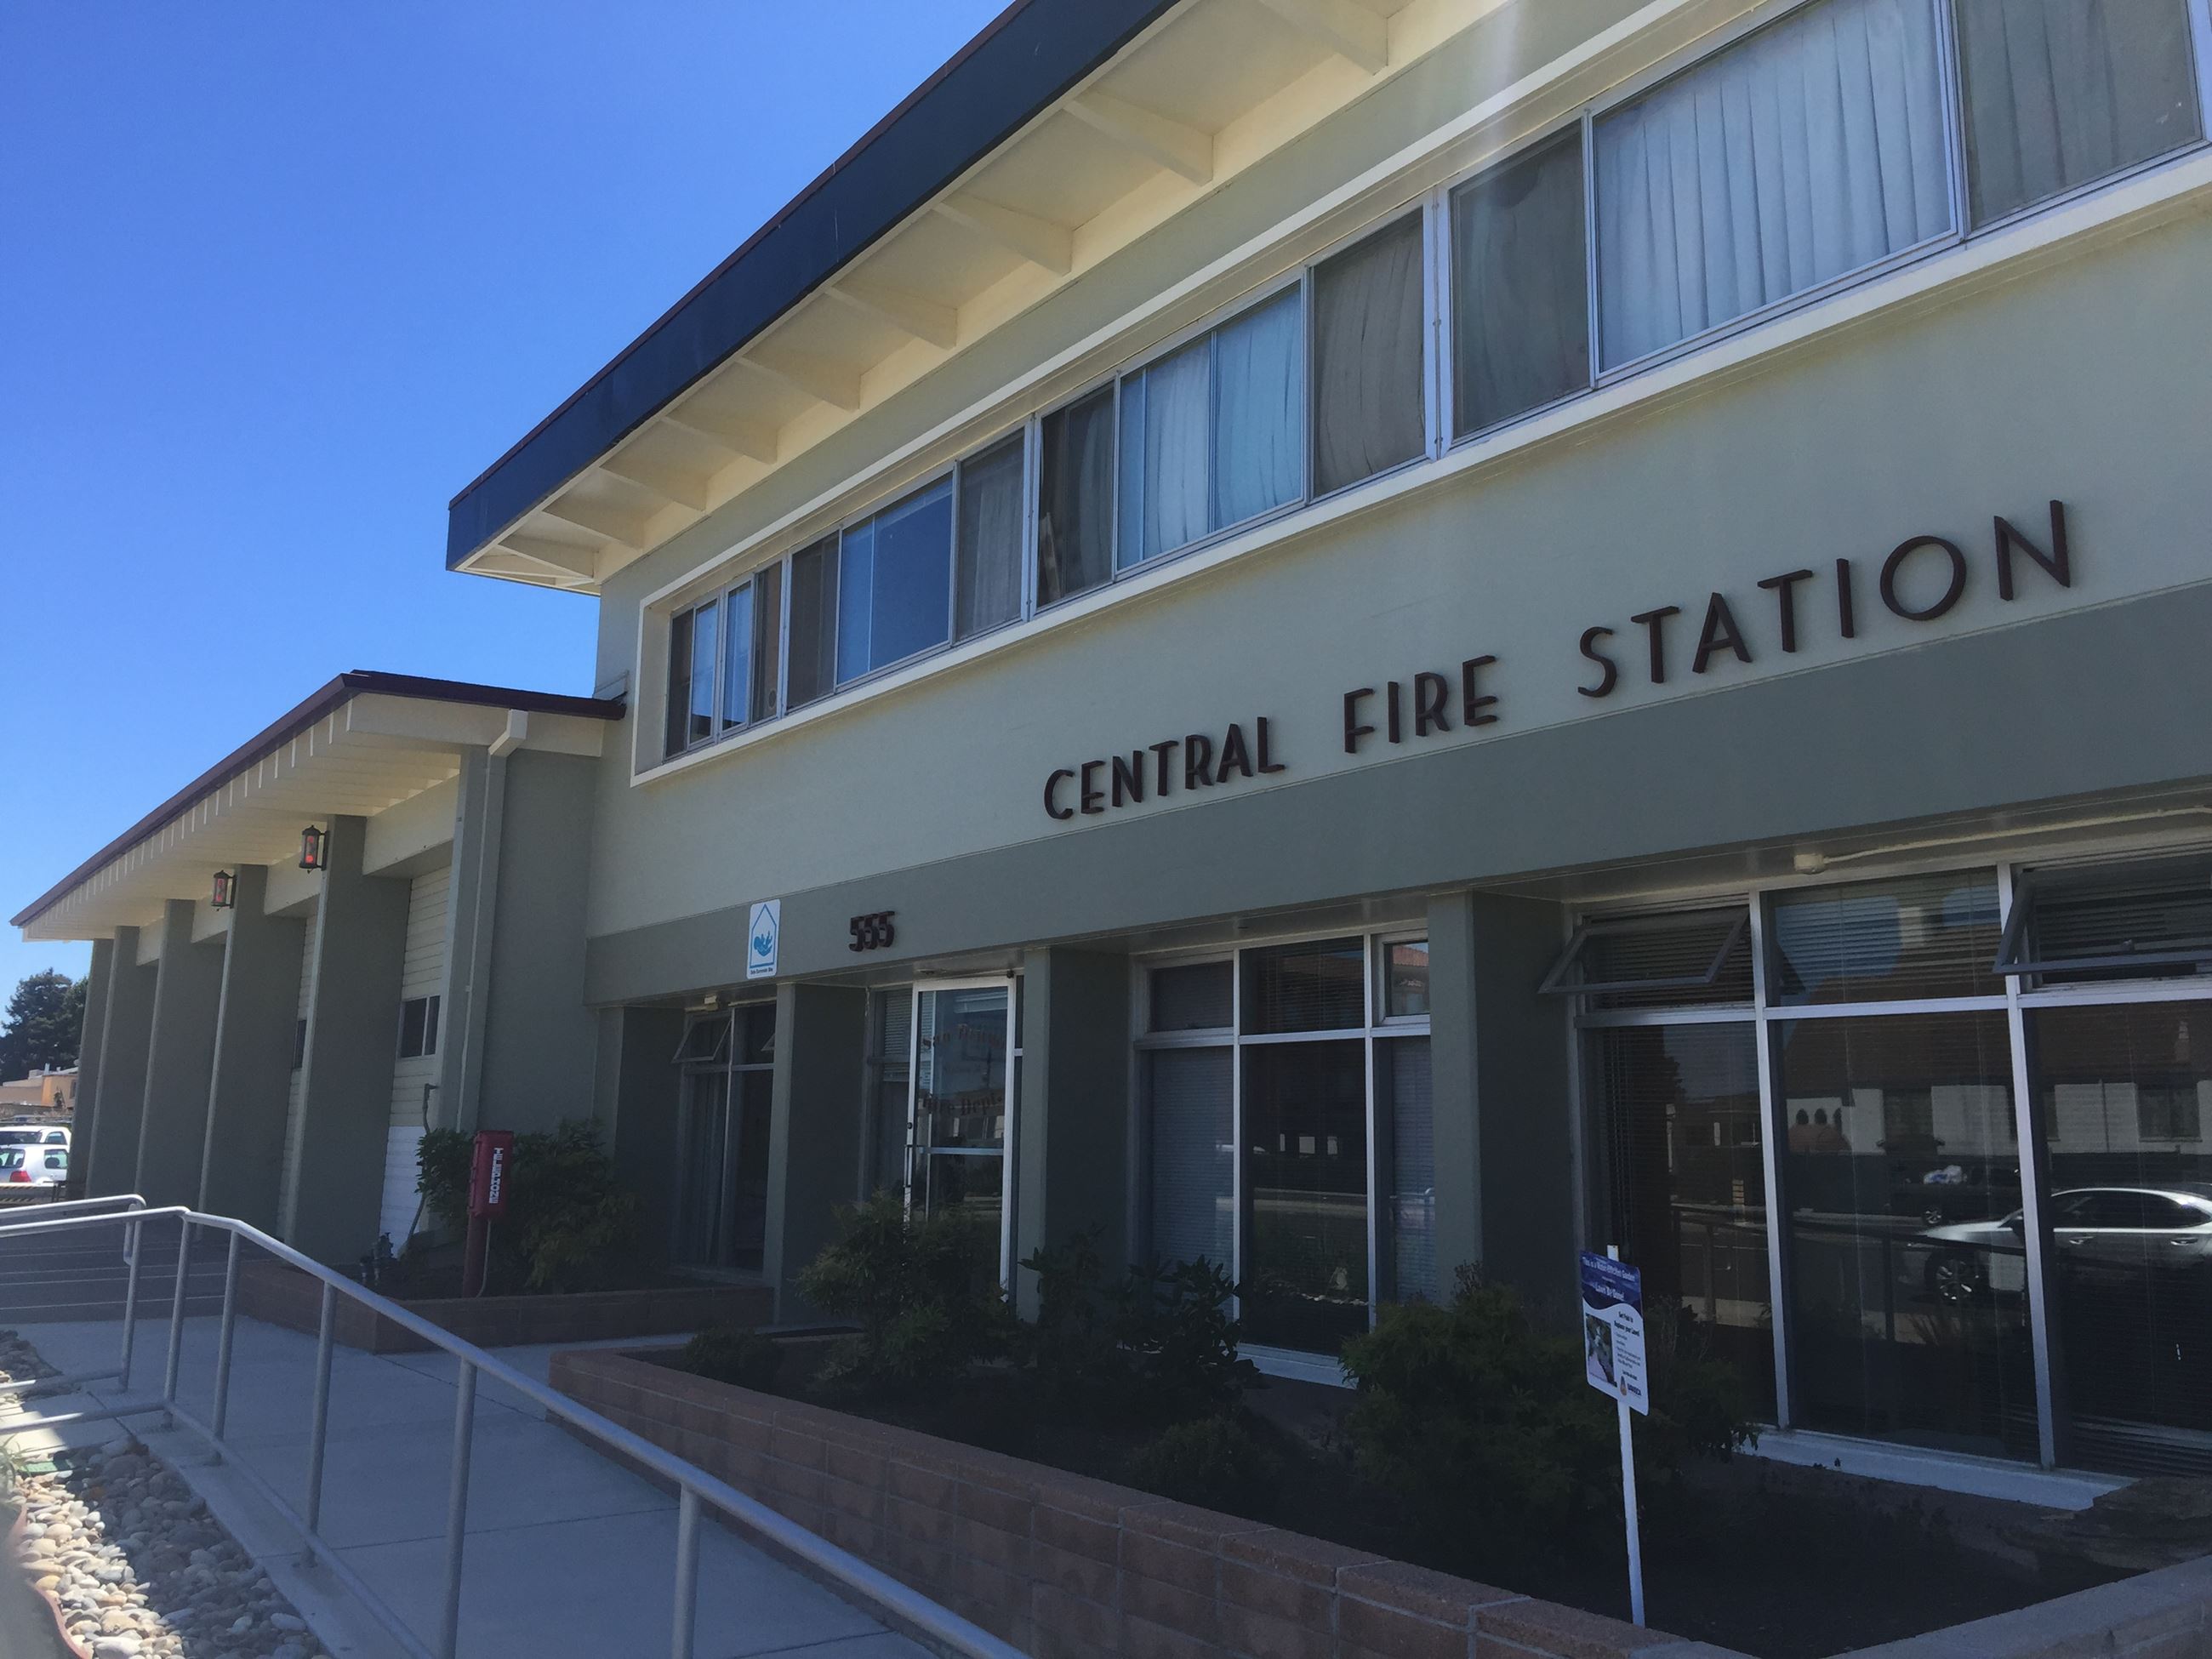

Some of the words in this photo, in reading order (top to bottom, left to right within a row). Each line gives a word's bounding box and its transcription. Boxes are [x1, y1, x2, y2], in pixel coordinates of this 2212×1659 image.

[1043, 715, 1286, 820] CENTRAL
[1343, 654, 1499, 754] FIRE
[1577, 499, 2072, 698] STATION
[849, 910, 895, 952] 555
[489, 1148, 504, 1204] TELEPHONE
